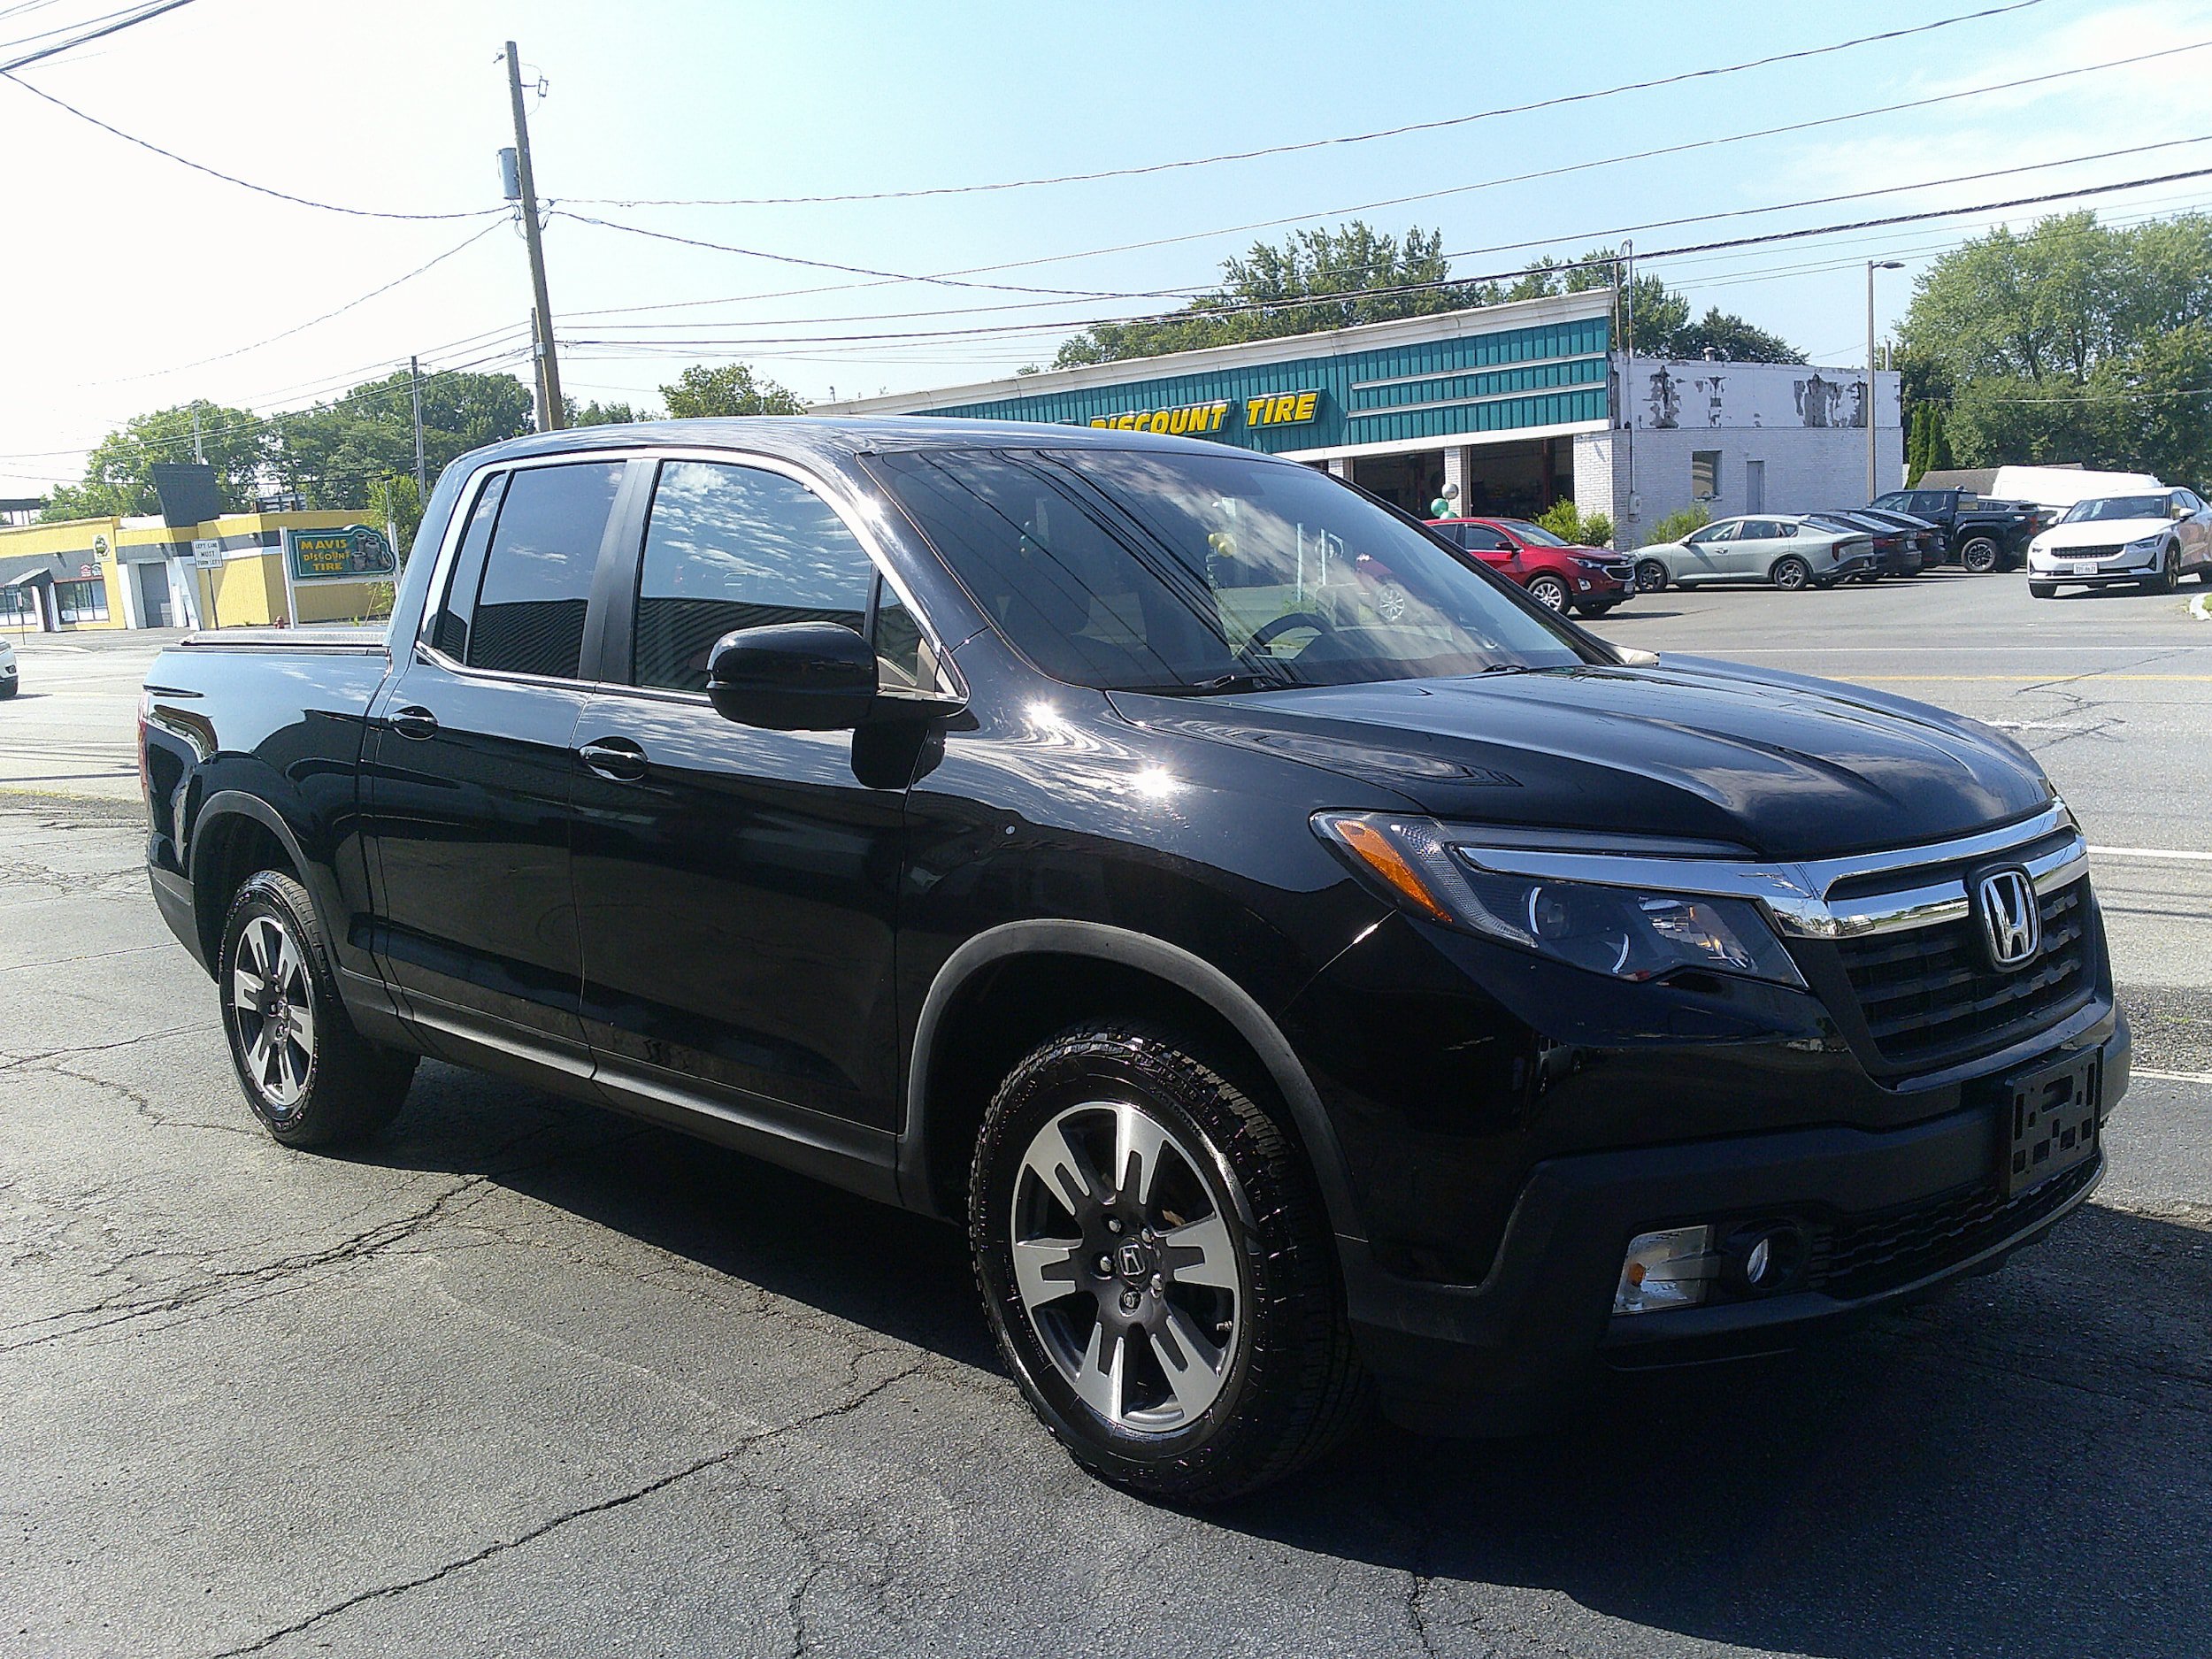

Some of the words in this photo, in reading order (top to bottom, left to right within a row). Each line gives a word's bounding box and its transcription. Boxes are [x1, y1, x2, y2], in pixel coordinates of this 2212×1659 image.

[1247, 392, 1318, 426] TIRE
[301, 539, 348, 550] MAVIS
[303, 550, 351, 561] DISCOUNT
[313, 562, 343, 572] TIRE
